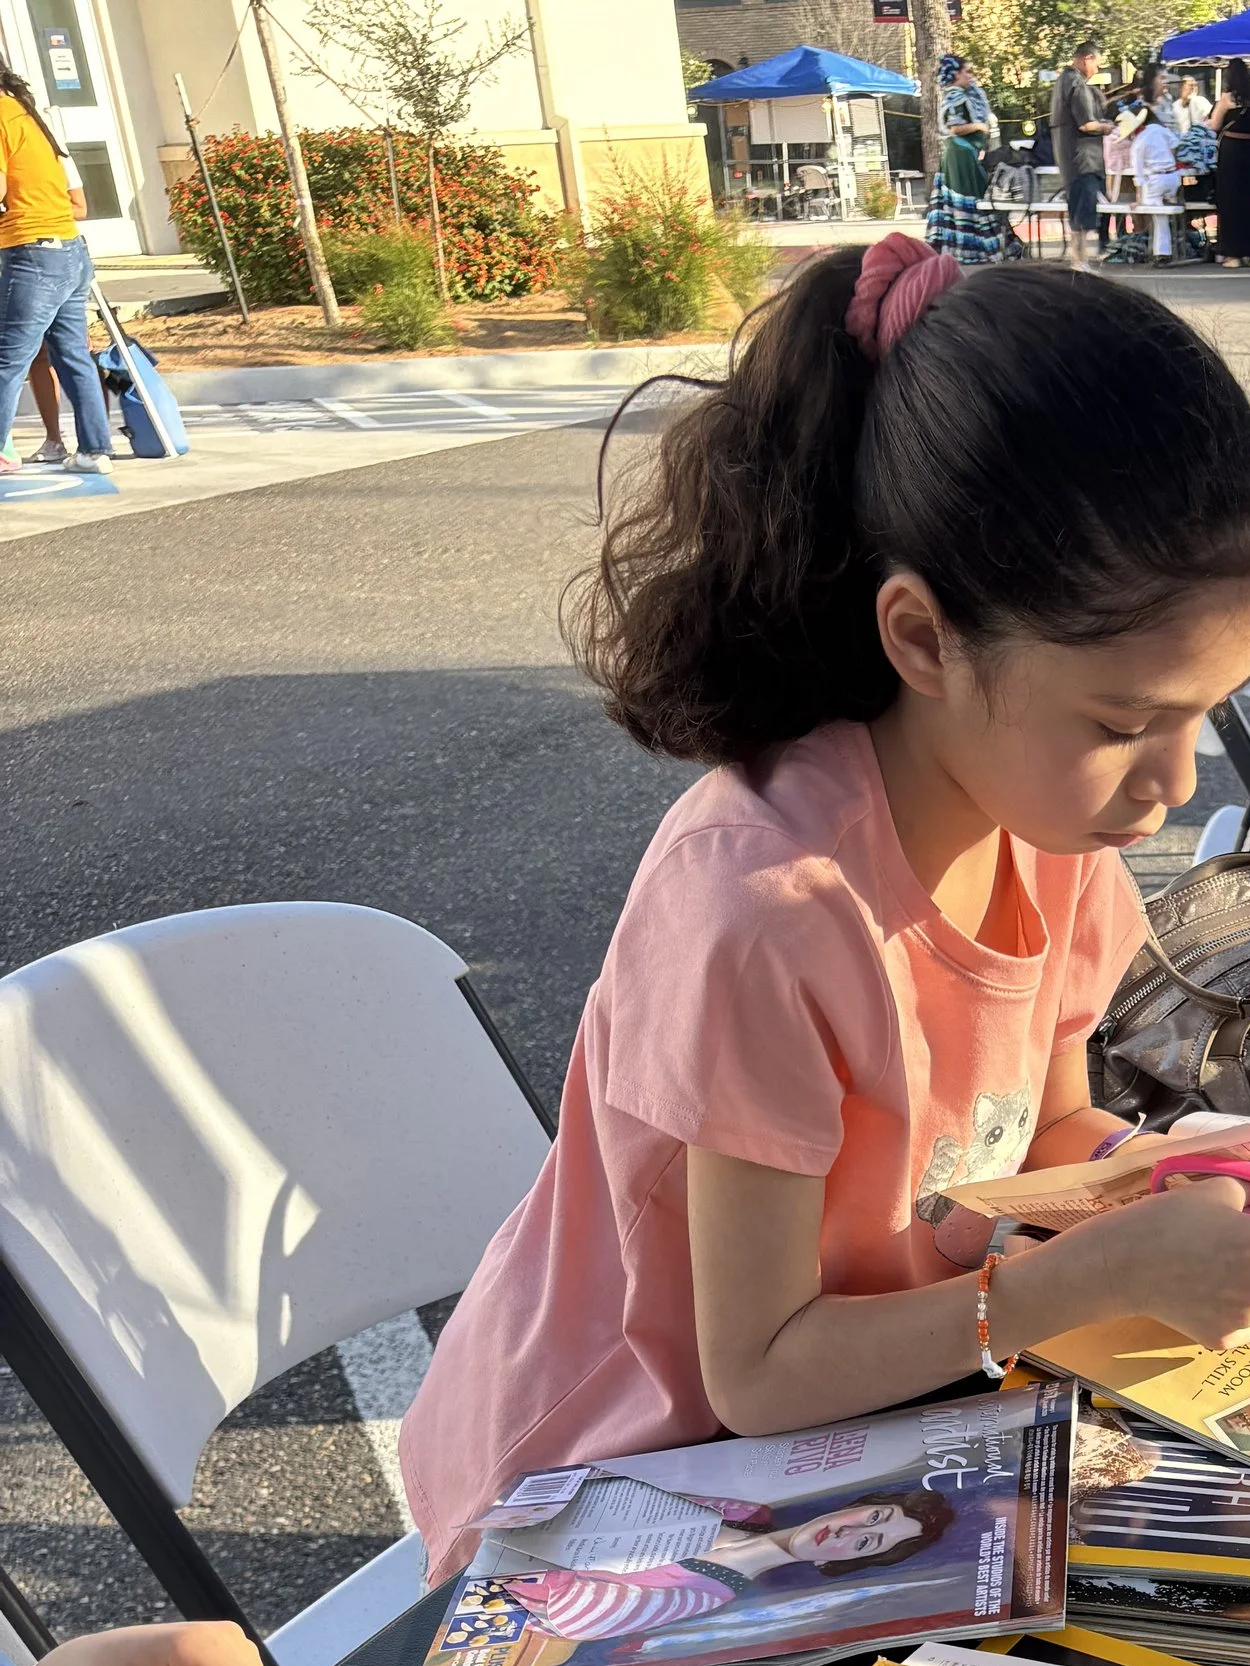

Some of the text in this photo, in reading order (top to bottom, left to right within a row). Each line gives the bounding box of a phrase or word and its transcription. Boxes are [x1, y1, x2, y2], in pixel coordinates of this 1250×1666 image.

[1201, 1358, 1236, 1387] SKILL
[823, 1424, 870, 1473] LENA
[919, 1408, 979, 1492] artist
[973, 1530, 992, 1617] WORLD'S BEST ARTISTS
[987, 1515, 1007, 1614] INSIDE THE STUDIOS OF THE
